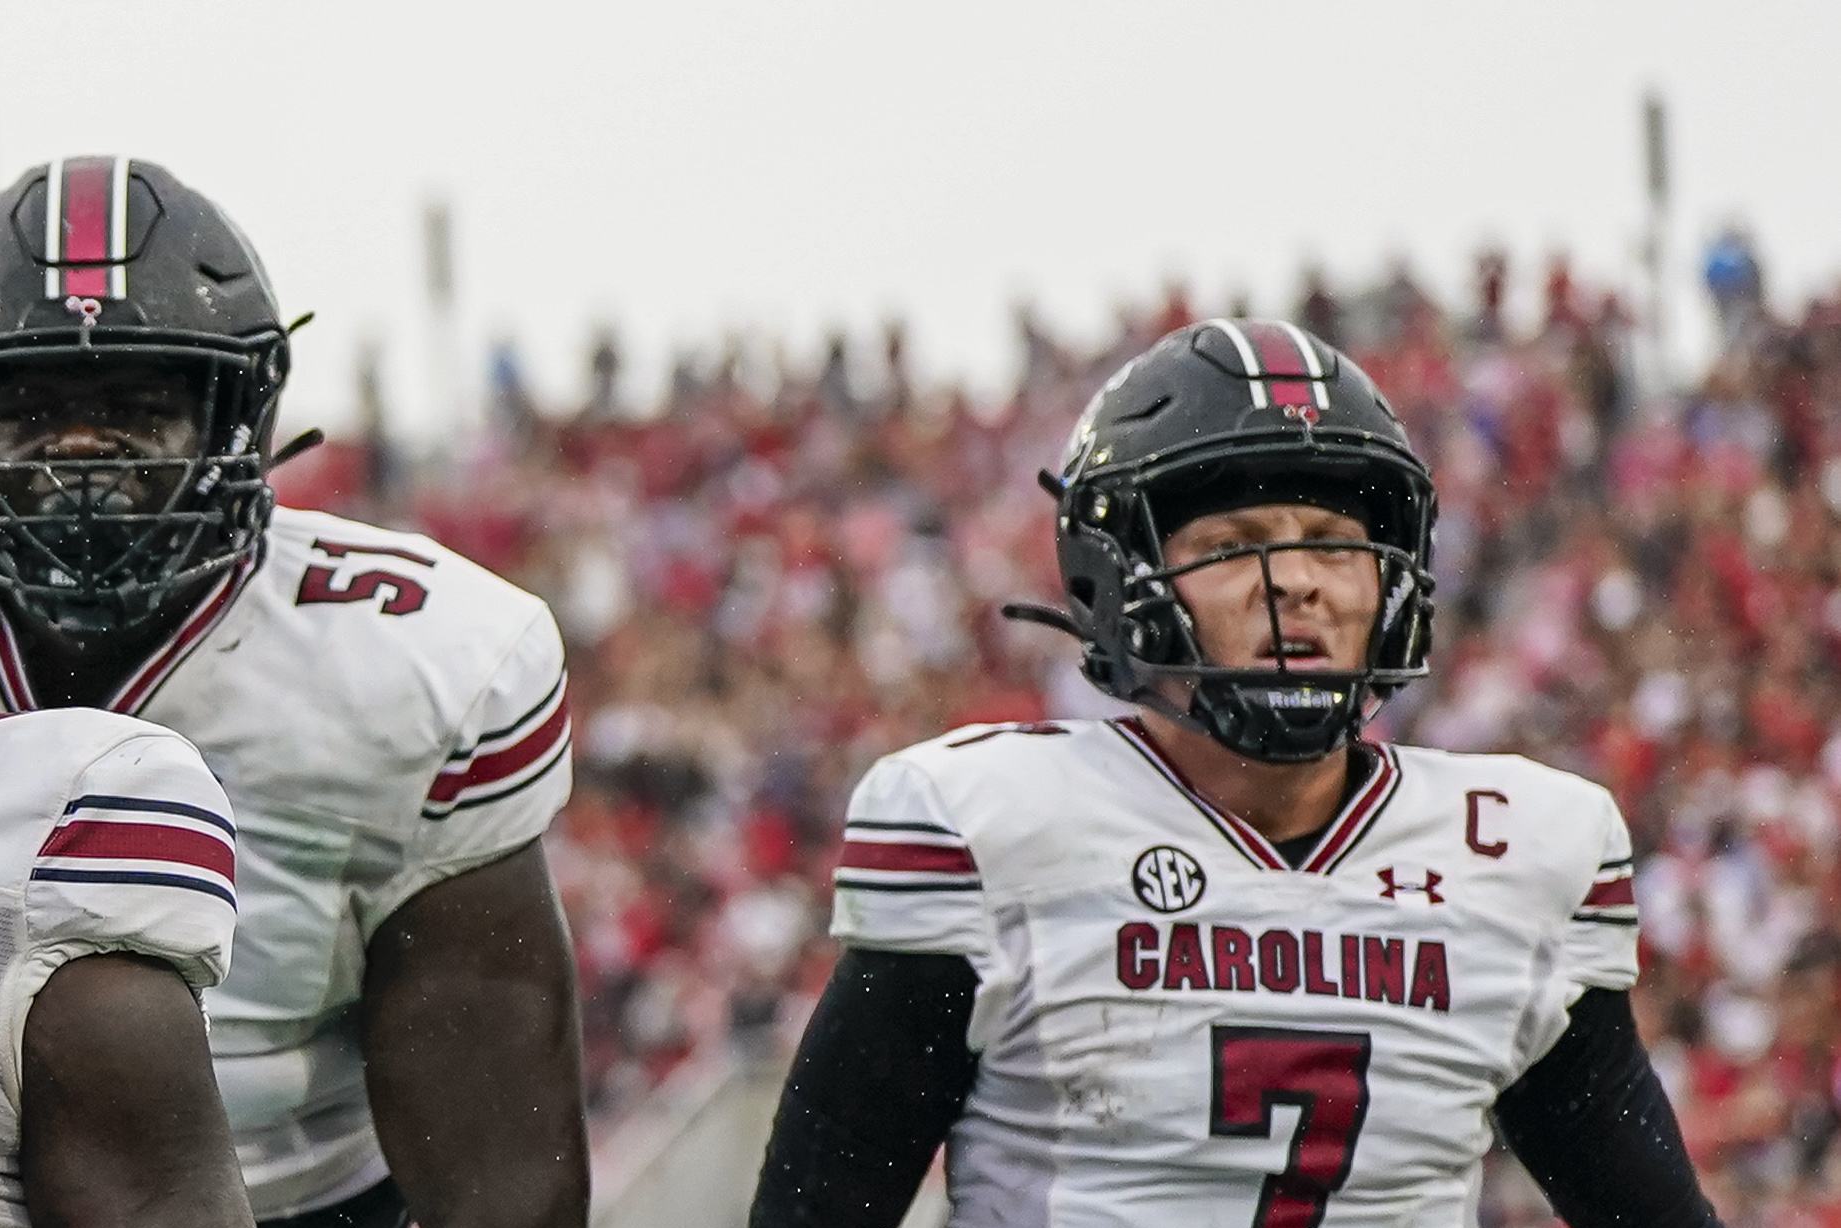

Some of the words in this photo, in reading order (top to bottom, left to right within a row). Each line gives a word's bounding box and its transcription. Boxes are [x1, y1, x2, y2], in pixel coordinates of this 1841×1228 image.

[295, 538, 437, 615] 51
[1466, 790, 1508, 859] C
[1138, 849, 1202, 910] SEC
[1116, 921, 1451, 1013] CAROLINA
